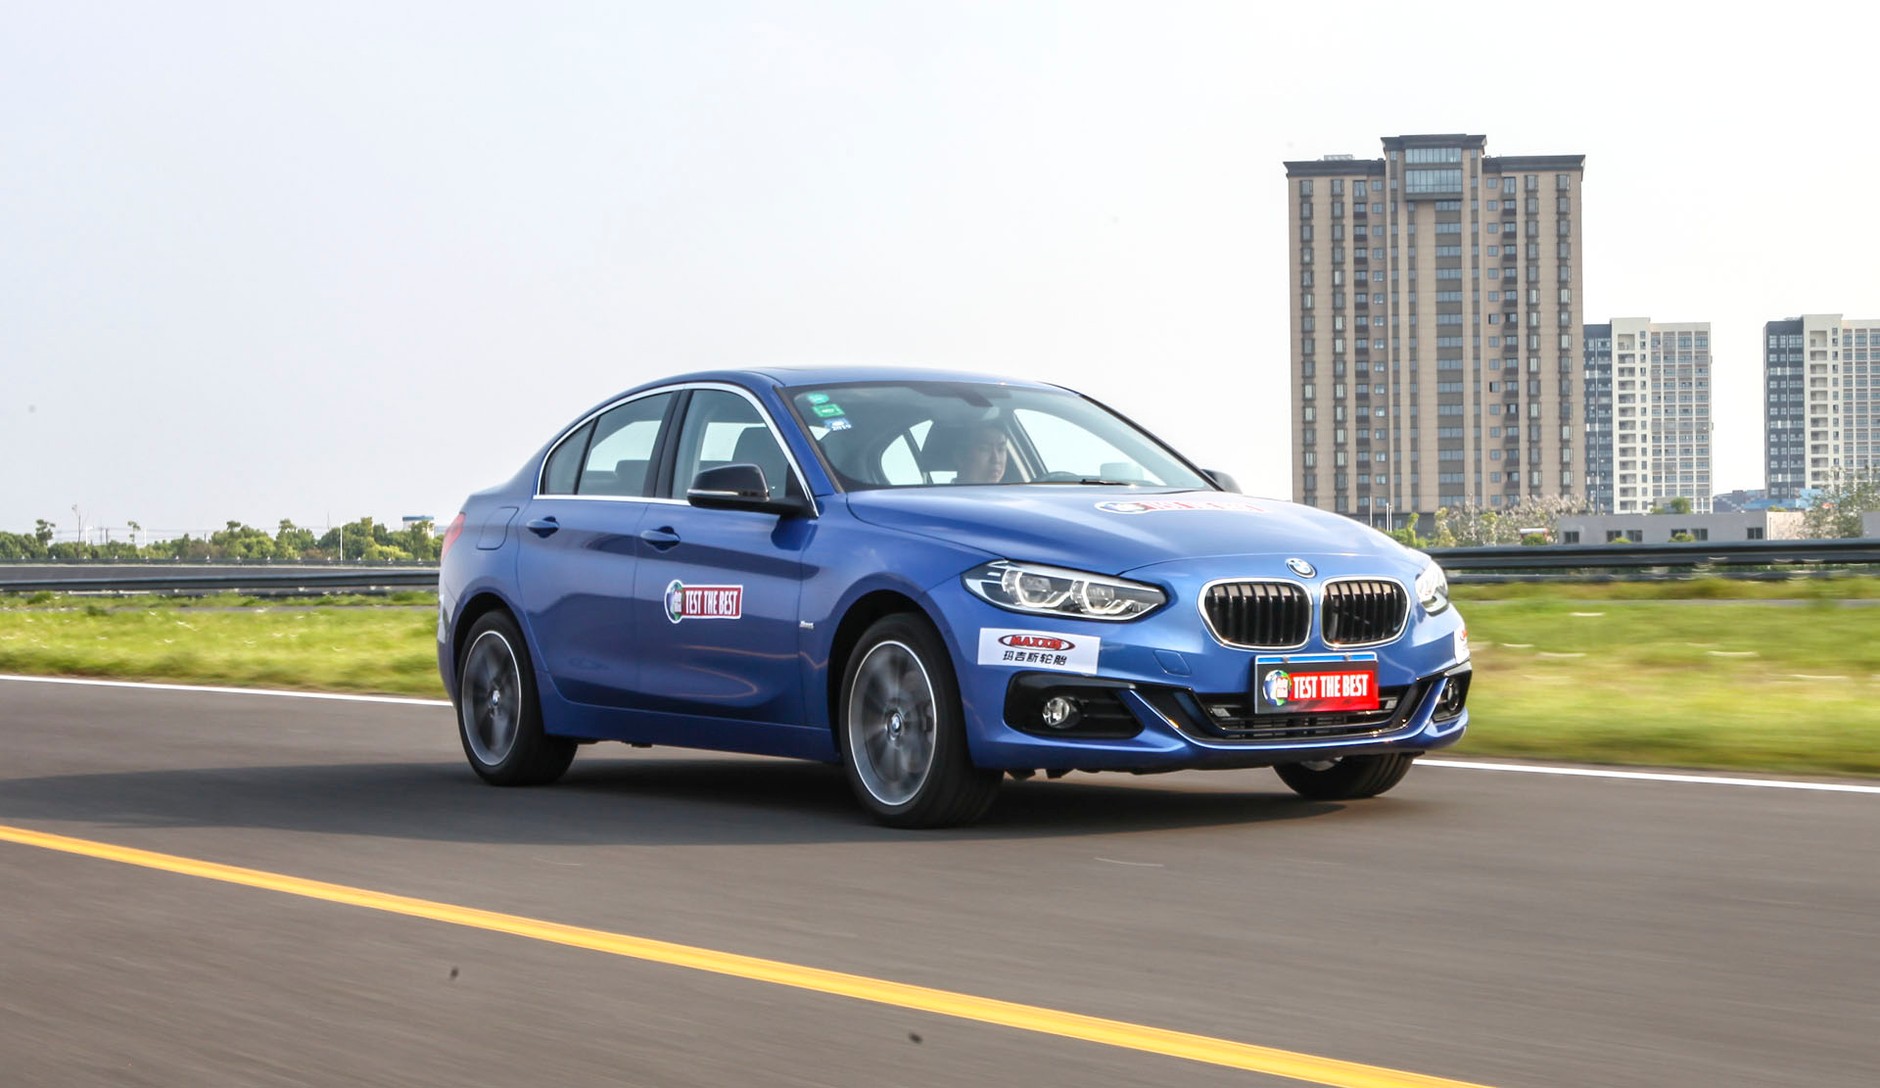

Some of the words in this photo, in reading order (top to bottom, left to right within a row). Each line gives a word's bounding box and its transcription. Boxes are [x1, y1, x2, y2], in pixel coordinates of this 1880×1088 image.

[685, 590, 702, 614] TEST
[703, 590, 718, 614] THE
[719, 591, 738, 615] BEST
[1002, 650, 1068, 666] 玛吉斯轮胎
[1293, 676, 1318, 699] TEST
[1319, 675, 1341, 697] THE
[1342, 674, 1369, 696] BEST
